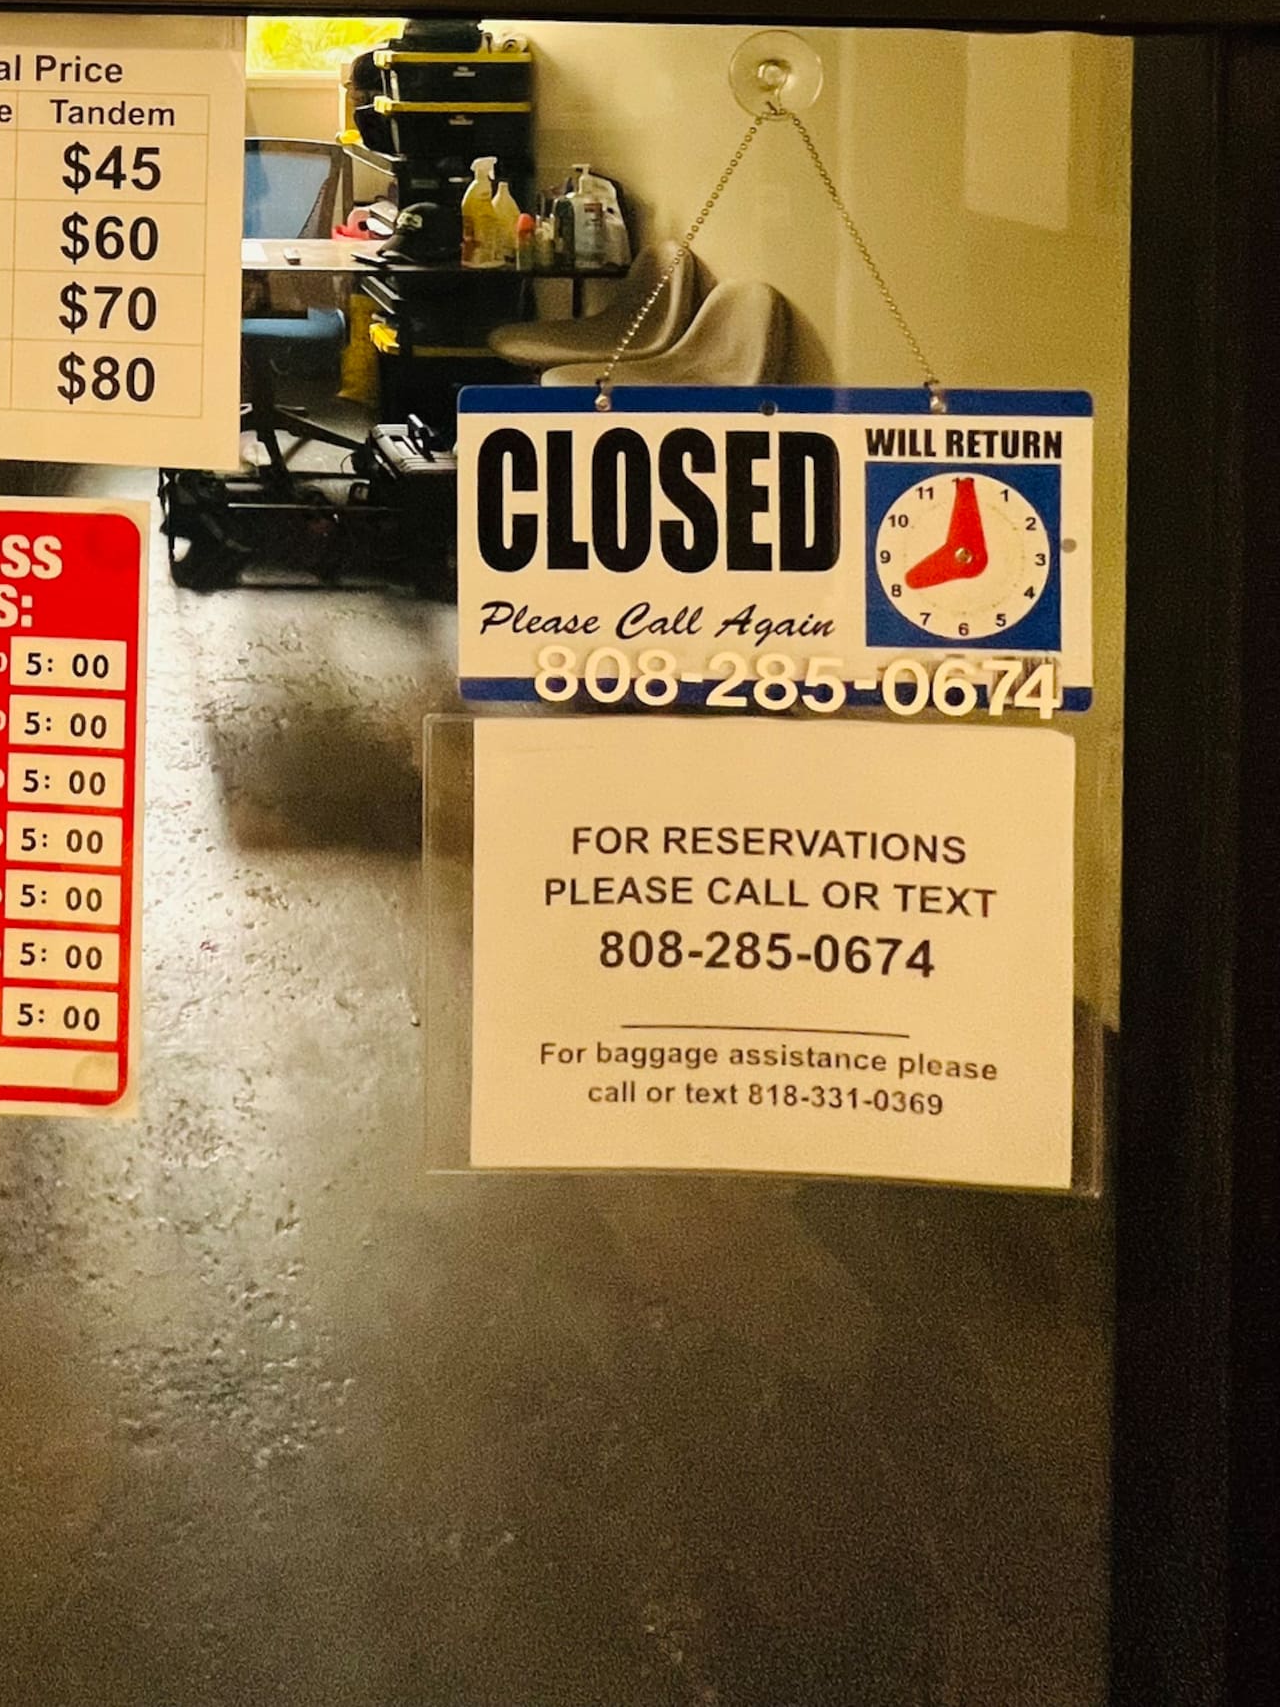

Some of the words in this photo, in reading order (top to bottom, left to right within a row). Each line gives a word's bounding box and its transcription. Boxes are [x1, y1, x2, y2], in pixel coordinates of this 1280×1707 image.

[34, 54, 124, 84] Price
[50, 99, 176, 127] Tandem
[61, 141, 162, 194] $45
[60, 212, 159, 265] $60
[59, 281, 157, 334] $70
[57, 351, 155, 404] $80
[865, 428, 937, 457] WILL
[946, 429, 1063, 459] RETURN
[477, 426, 841, 574] CLOSED
[916, 487, 934, 500] 11
[1001, 489, 1009, 502] 1
[888, 514, 909, 528] 10
[1025, 517, 1037, 531] 2
[880, 550, 891, 564] 9
[1035, 553, 1046, 566] 3
[891, 584, 902, 598] 8
[1024, 586, 1036, 599] 4
[480, 600, 600, 637] Please
[615, 601, 703, 638] Call
[714, 604, 836, 647] Again
[920, 612, 932, 626] 7
[958, 622, 969, 636] 6
[995, 614, 1007, 627] 5
[534, 644, 1061, 720] 808-285-0674
[572, 826, 649, 854] FOR
[663, 827, 967, 864] RESERVATIONS
[544, 876, 694, 906] PLEASE
[707, 877, 809, 908] CALL
[822, 881, 880, 911] OR
[894, 883, 997, 918] TEXT
[599, 930, 935, 978] 808-285-0674
[540, 1042, 586, 1065] For
[596, 1042, 719, 1070] baggage
[729, 1045, 888, 1073] assistance
[898, 1053, 998, 1081] please
[587, 1082, 636, 1104] call
[645, 1085, 676, 1105] or
[685, 1084, 739, 1106] text
[748, 1082, 944, 1116] 818-331-0369
